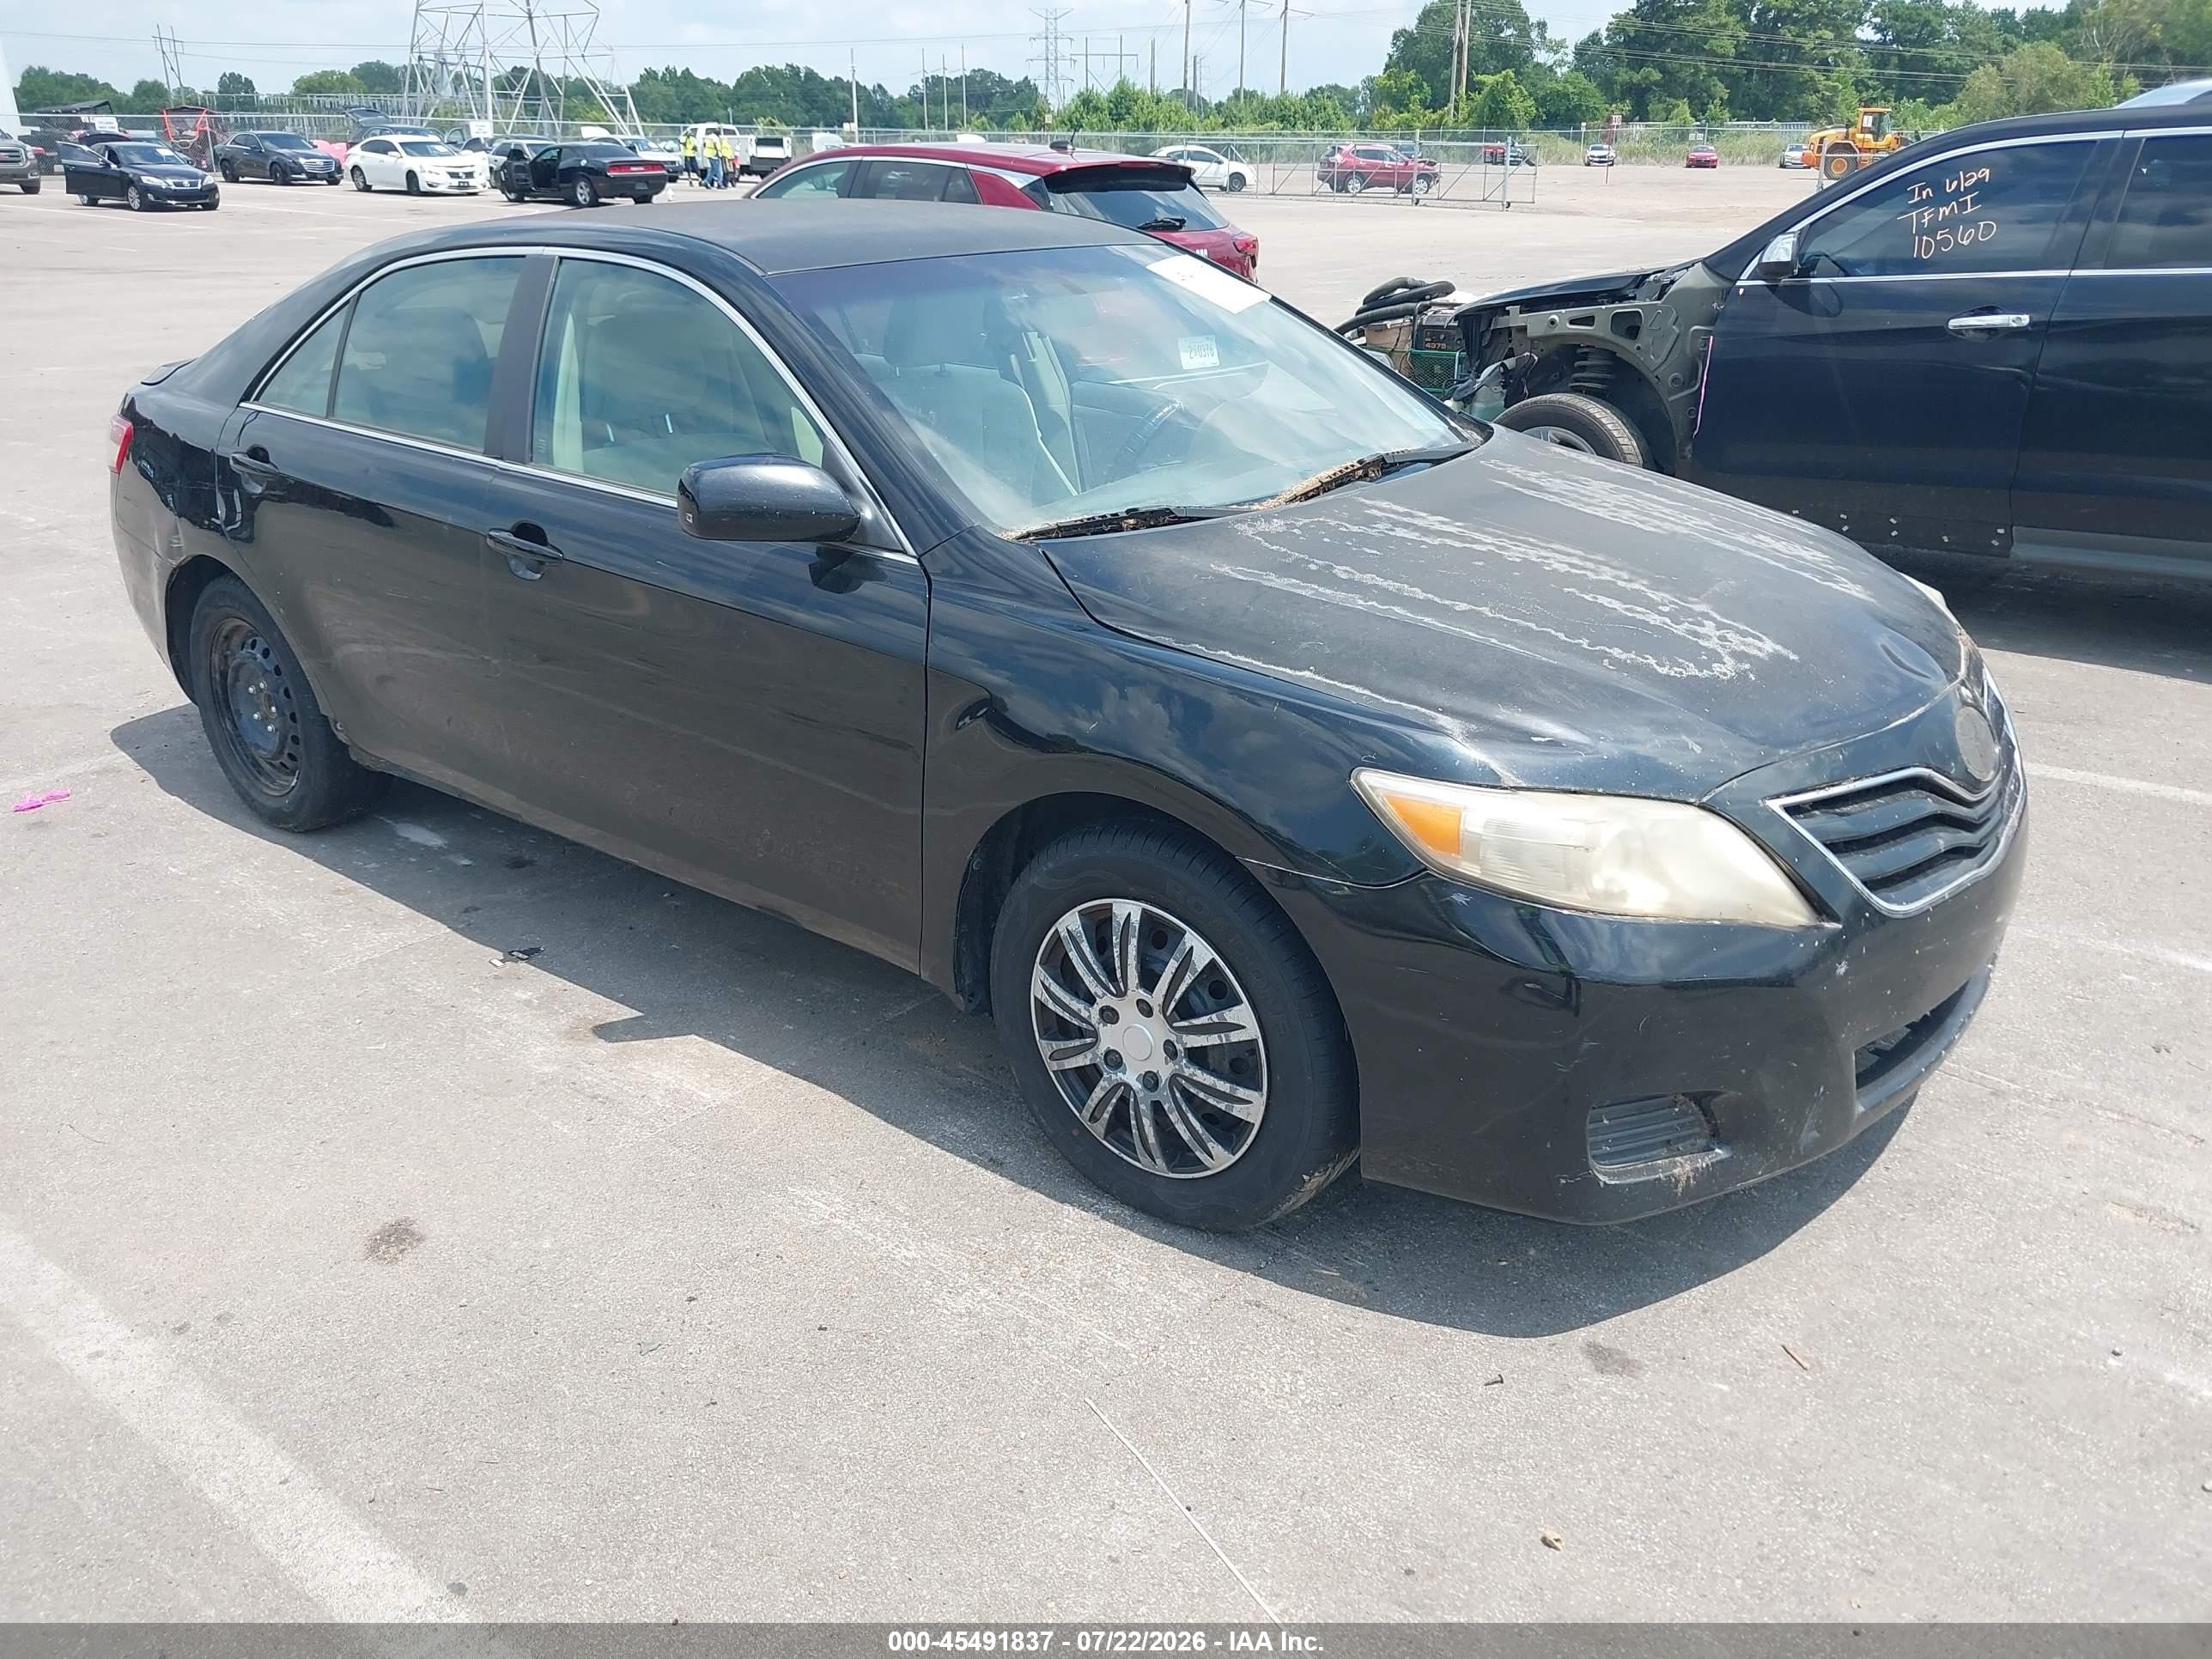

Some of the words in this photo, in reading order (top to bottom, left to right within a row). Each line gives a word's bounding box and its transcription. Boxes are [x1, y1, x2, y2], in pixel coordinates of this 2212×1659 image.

[1906, 181, 1934, 204] In
[1945, 167, 1990, 193] 6/29
[1896, 191, 1983, 234] TFMI
[1913, 220, 1997, 260] 10560
